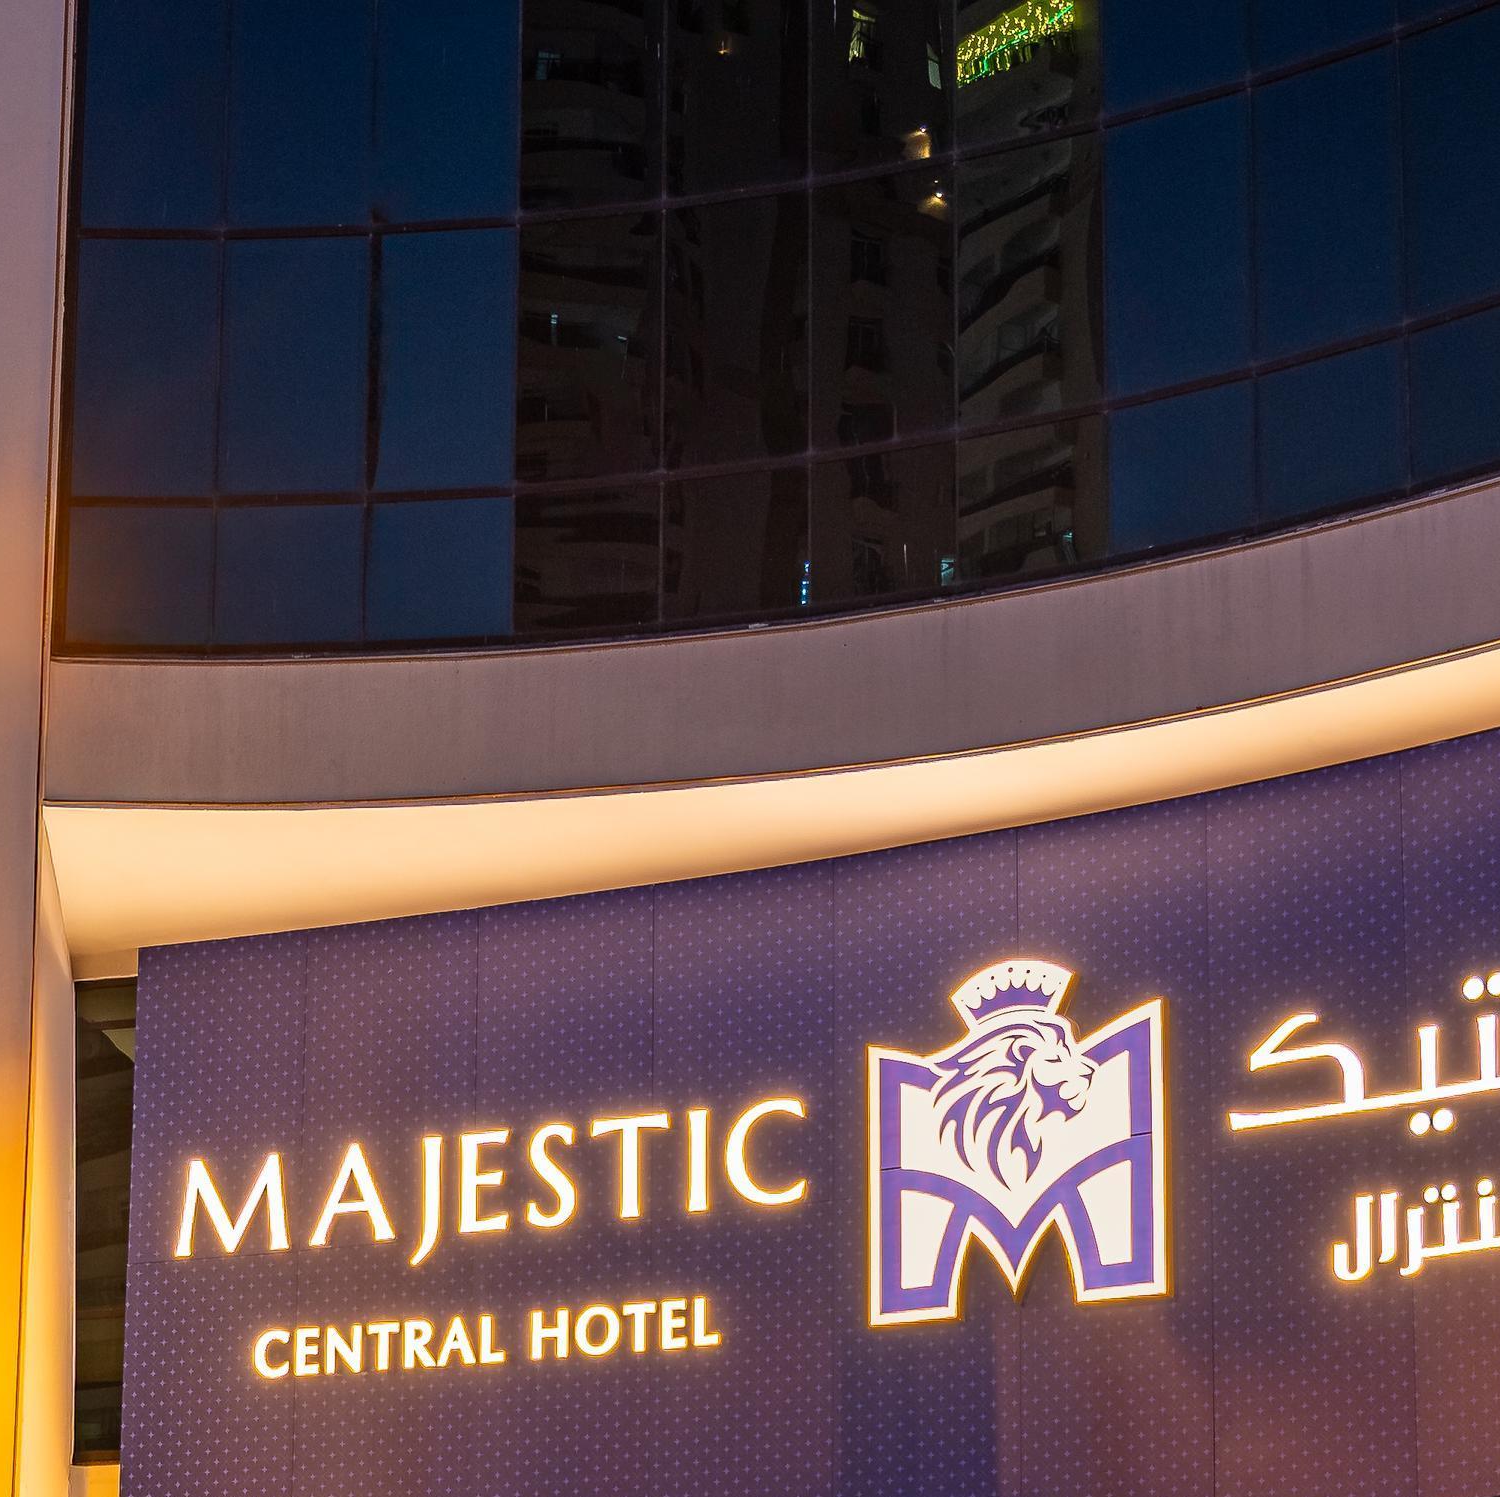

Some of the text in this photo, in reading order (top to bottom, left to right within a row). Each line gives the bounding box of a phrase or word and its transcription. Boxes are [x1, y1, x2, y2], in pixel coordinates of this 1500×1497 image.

[173, 1098, 807, 1267] MAJESTIC
[252, 1296, 720, 1380] CENTRAL HOTEL
